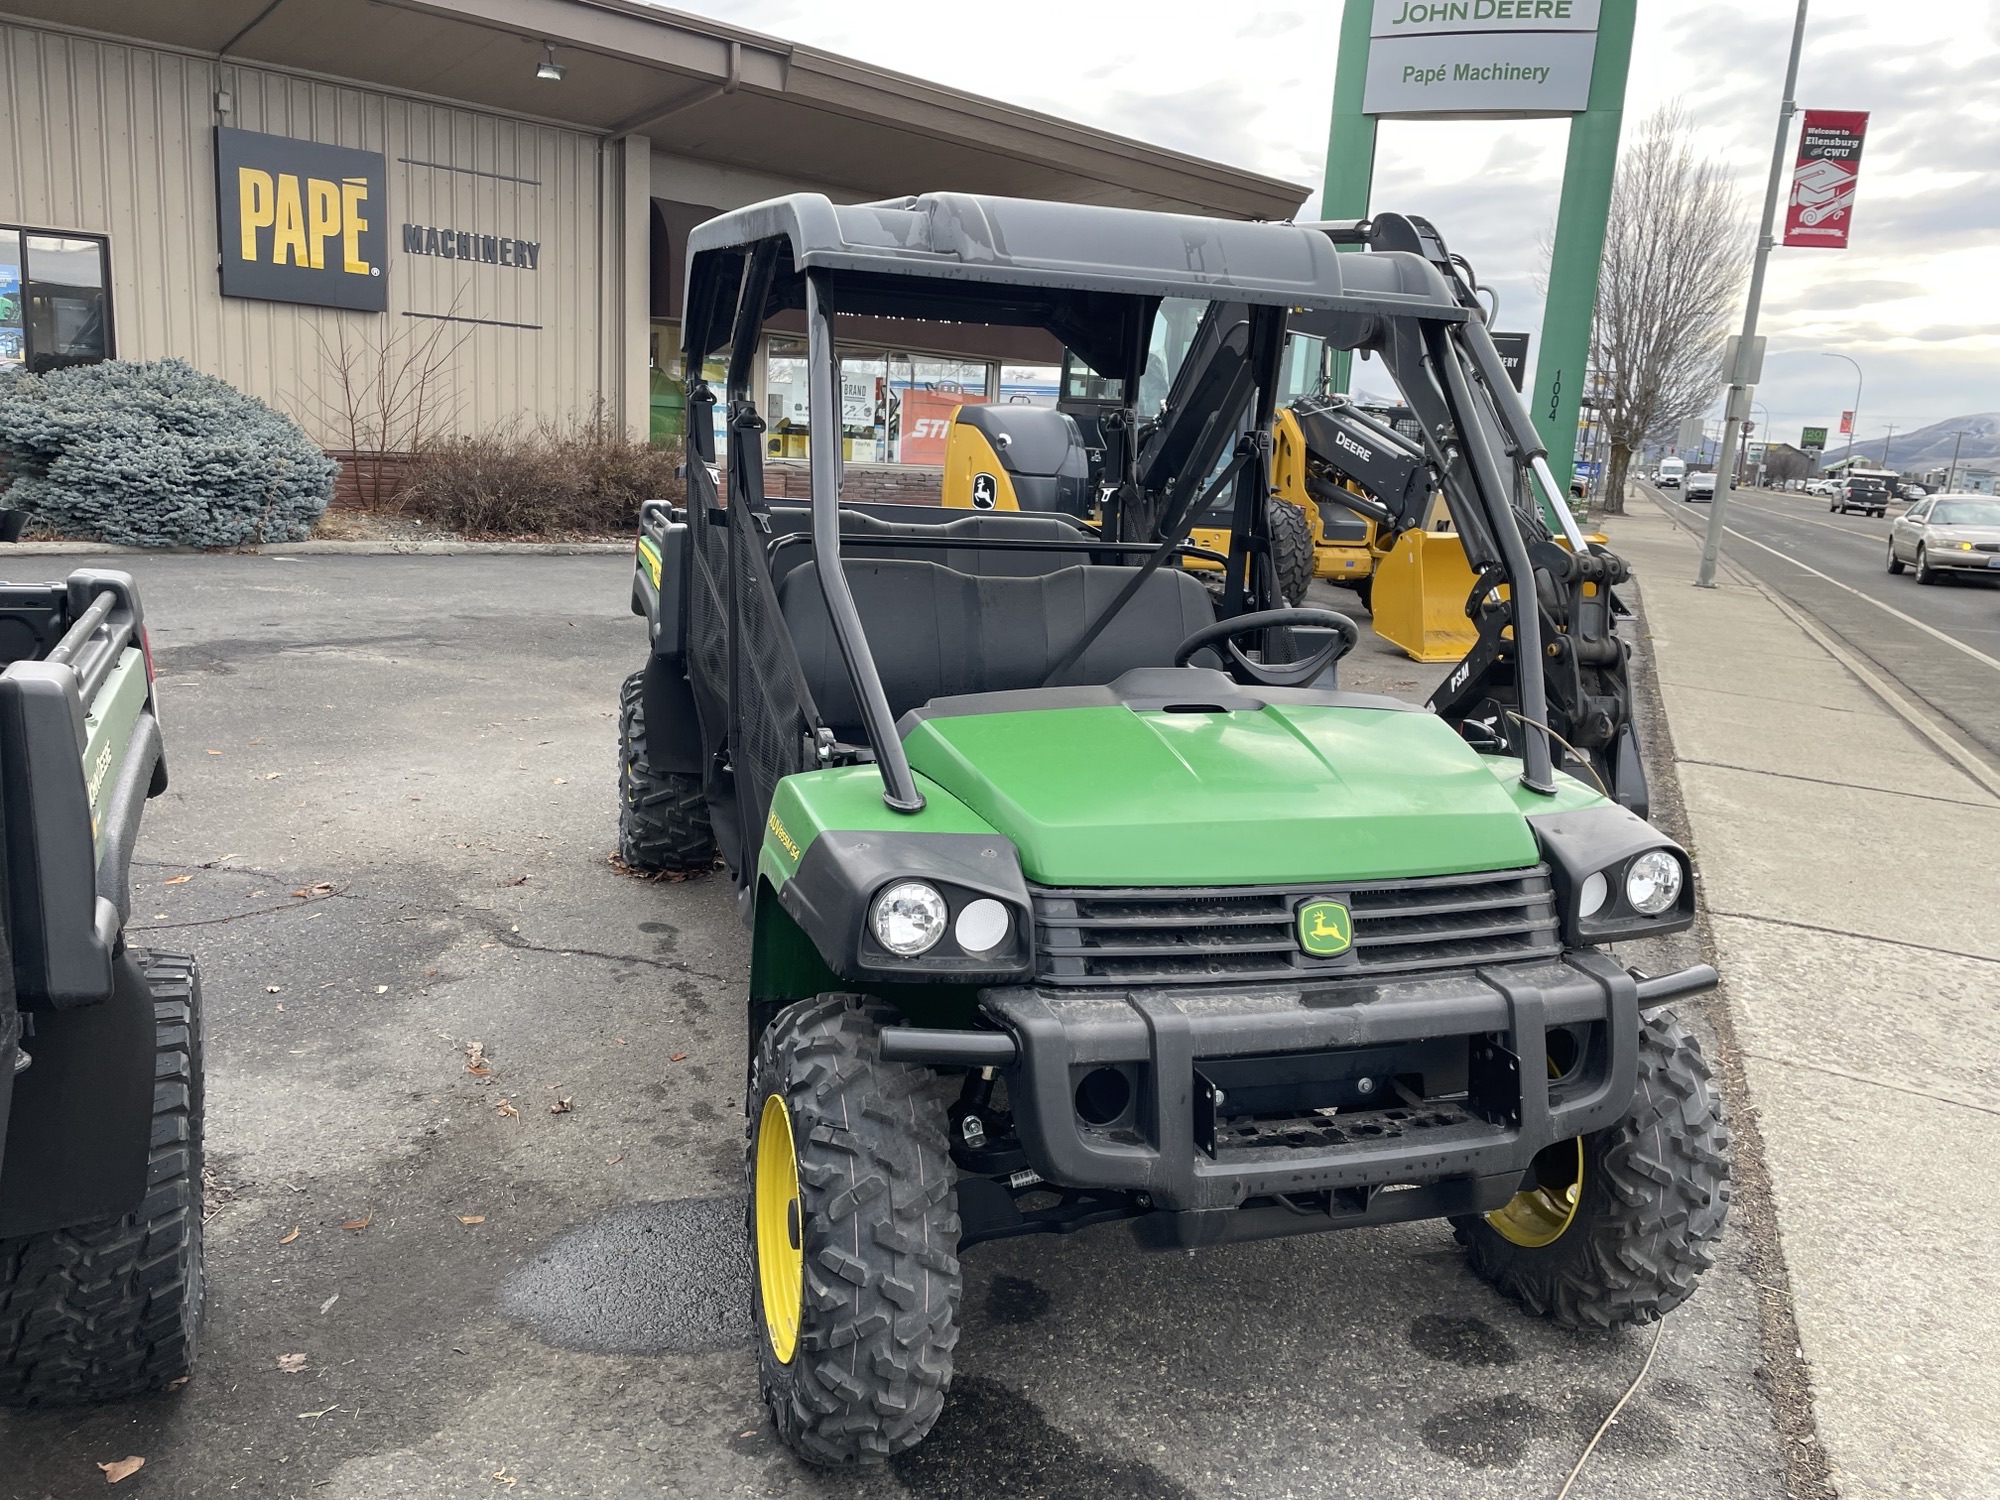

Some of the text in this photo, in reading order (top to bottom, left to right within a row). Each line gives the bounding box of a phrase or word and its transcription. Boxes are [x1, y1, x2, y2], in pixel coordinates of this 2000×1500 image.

[1392, 0, 1573, 25] JOHN DEERE
[1402, 63, 1551, 86] Papé Machinery
[1805, 136, 1860, 148] Ellensburg
[1807, 127, 1841, 135] Welcome
[1824, 148, 1850, 157] CWU
[239, 167, 370, 275] PAPÉ
[403, 223, 541, 270] MACHINERY
[844, 384, 867, 397] BRAND
[1548, 369, 1561, 422] 1004
[912, 418, 951, 440] STI
[1335, 431, 1372, 462] DEERE
